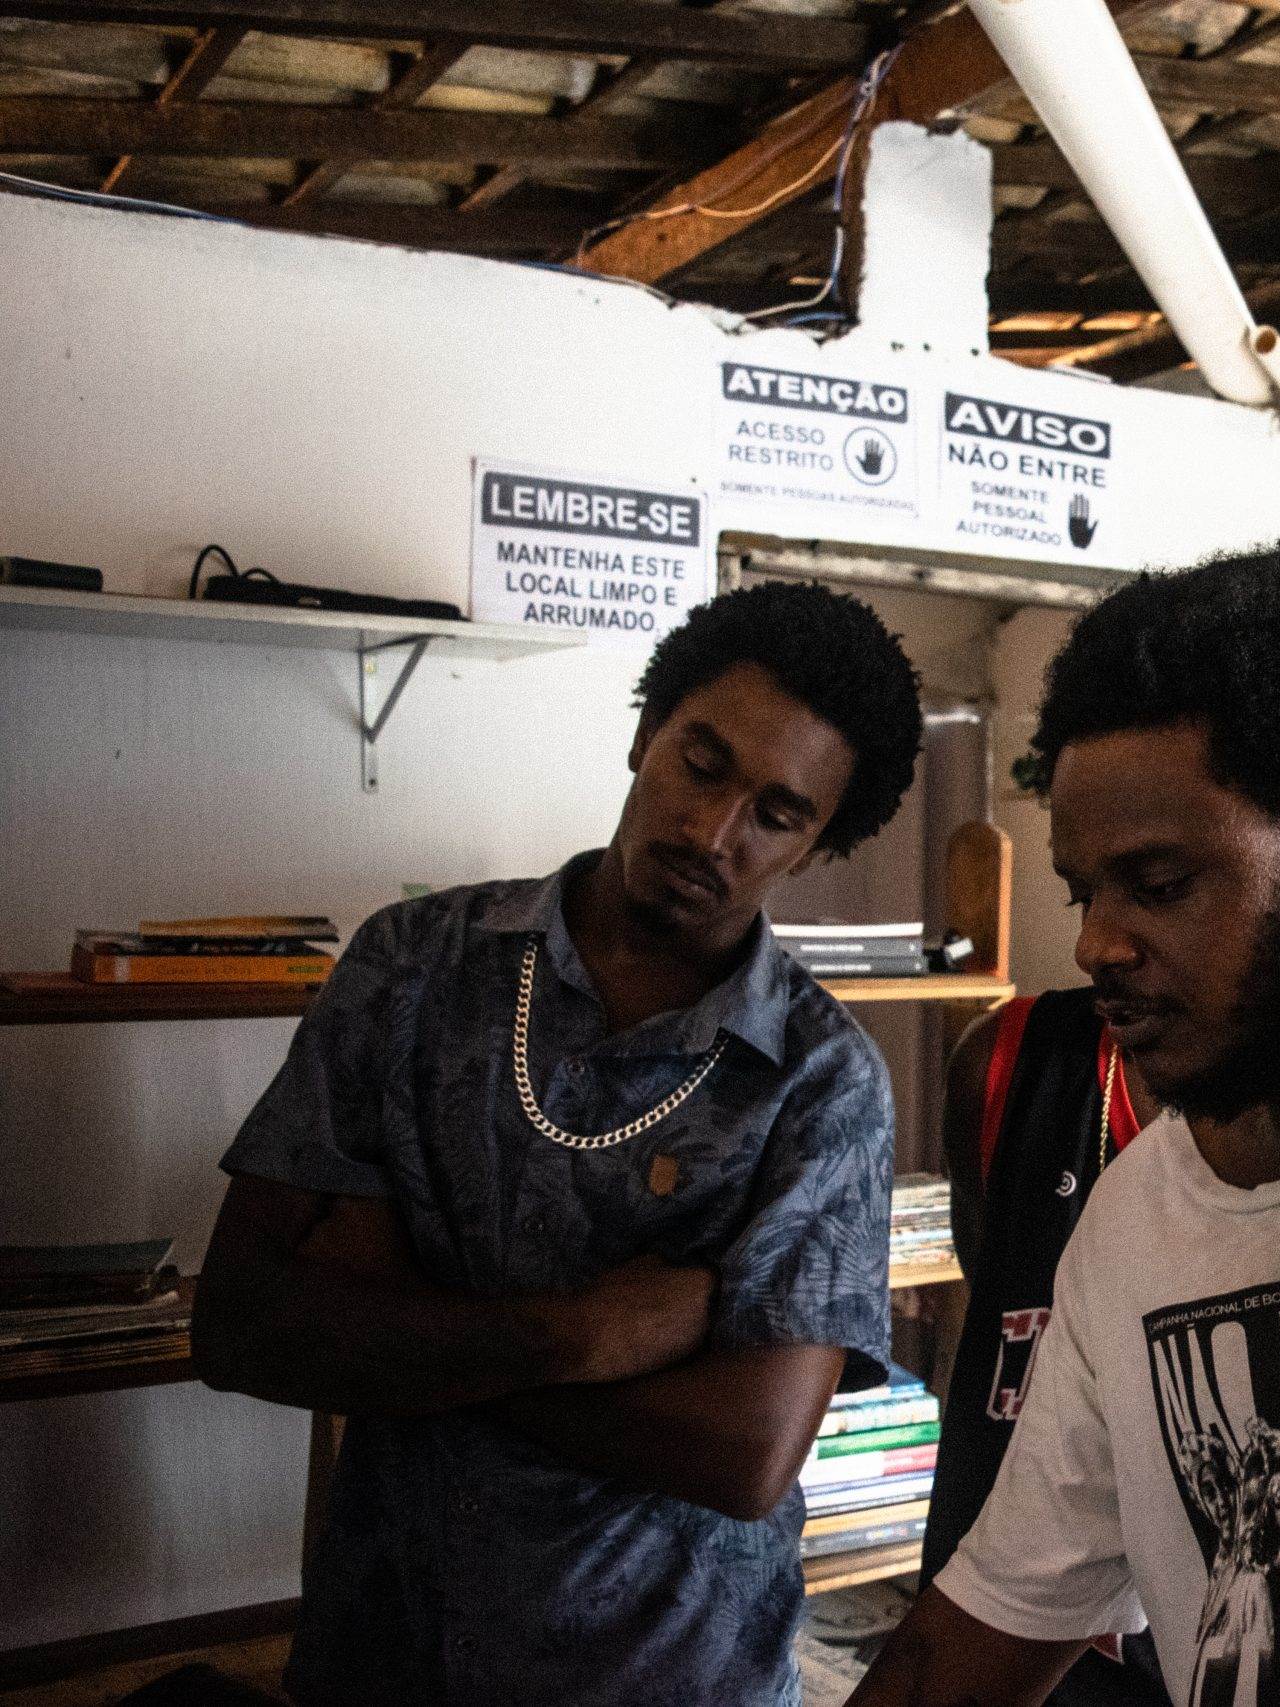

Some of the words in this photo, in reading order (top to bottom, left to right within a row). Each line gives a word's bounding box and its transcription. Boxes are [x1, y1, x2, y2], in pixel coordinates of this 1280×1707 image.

[726, 367, 906, 416] ATENÇÃO
[737, 420, 825, 445] ACESSO
[950, 401, 1107, 453] AVISO
[728, 444, 834, 471] RESTRITO
[948, 442, 1008, 471] NÃO
[1019, 454, 1106, 488] ENTRE
[971, 480, 1050, 504] SOMENTE
[490, 482, 692, 538] LEMBRE-SE
[973, 500, 1047, 524] PESSOAL
[957, 519, 1061, 546] AUTORIZADO
[497, 540, 625, 574] MANTENHA
[631, 554, 685, 580] ESTE
[505, 570, 581, 599] LOCAL
[590, 579, 657, 604] LIMPO
[664, 586, 678, 607] E
[523, 601, 656, 632] ARRUMADO
[1191, 1301, 1241, 1320] NACIONAL
[1244, 1295, 1260, 1310] DE
